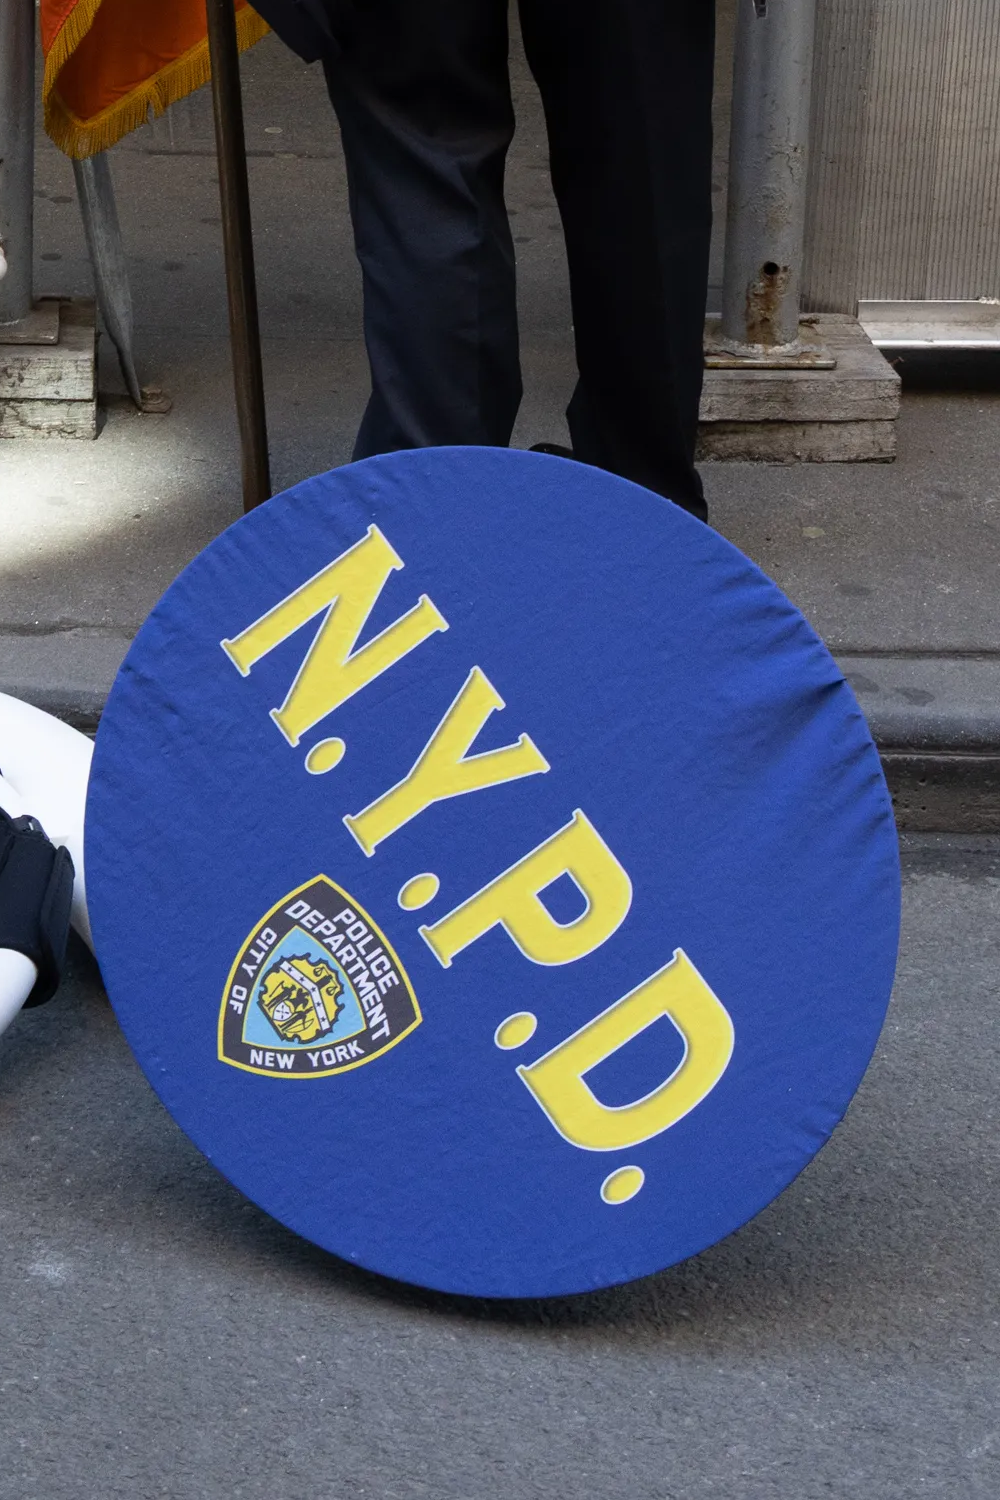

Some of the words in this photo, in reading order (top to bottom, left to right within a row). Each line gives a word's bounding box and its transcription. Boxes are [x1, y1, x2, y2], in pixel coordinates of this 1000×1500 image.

[219, 523, 736, 1205] N.Y.P.D.
[242, 926, 277, 979] CITY
[285, 899, 391, 1041] DEPARTMENT
[333, 907, 400, 995] POLICE
[229, 985, 248, 1015] OF
[250, 1049, 295, 1069] NEW
[307, 1040, 365, 1068] YORK
